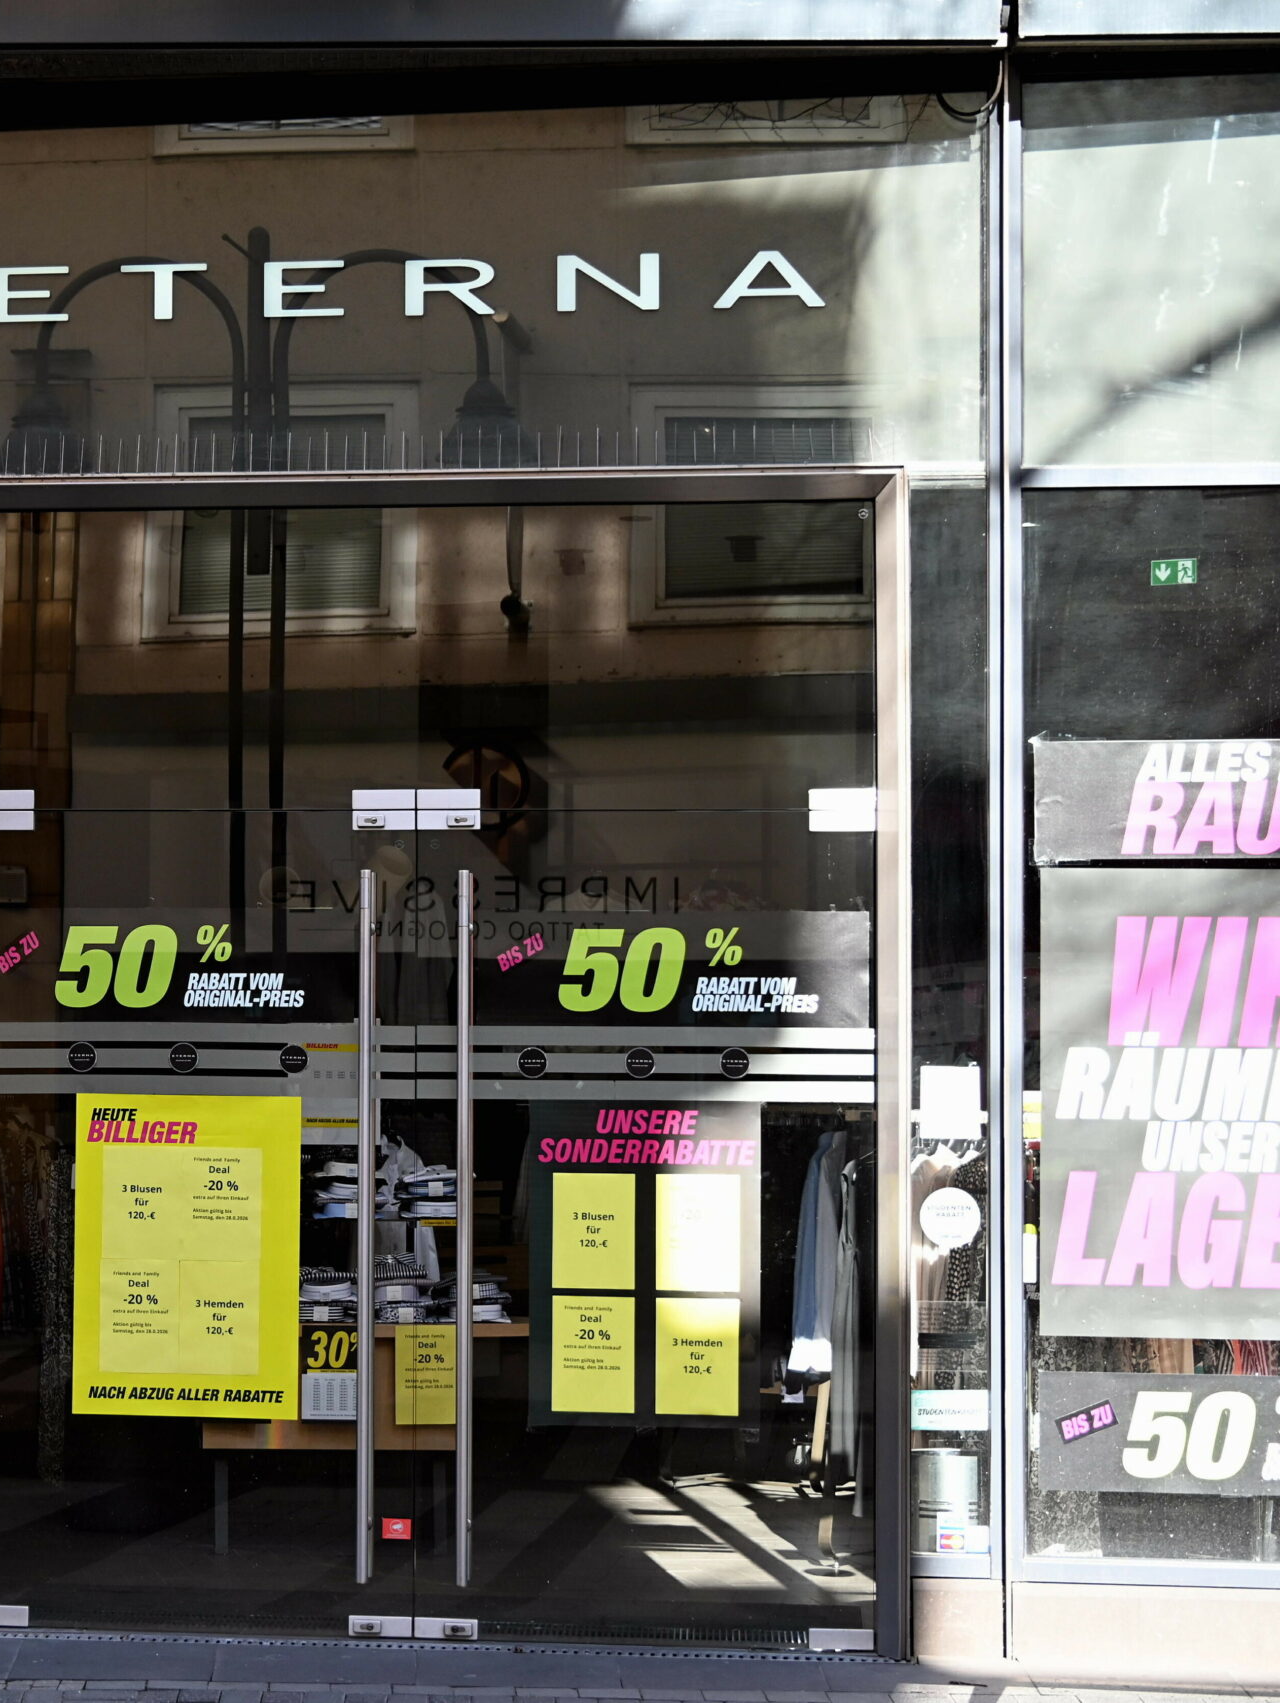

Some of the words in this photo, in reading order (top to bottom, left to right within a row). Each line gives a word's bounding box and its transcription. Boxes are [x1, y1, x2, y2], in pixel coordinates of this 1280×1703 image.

[1136, 742, 1272, 782] ALLES
[19, 931, 41, 956] ZU
[497, 945, 524, 972] BIS
[523, 933, 545, 957] ZU
[55, 924, 178, 1009] 50
[197, 923, 233, 963] %
[559, 927, 687, 1013] 50
[706, 927, 743, 967] %
[188, 973, 245, 991] RABATT
[249, 973, 284, 991] VOM
[696, 976, 757, 996] RABATT
[760, 977, 797, 996] VOM
[184, 988, 305, 1008] ORIGINAL-PREIS
[692, 993, 819, 1014] ORIGINAL-PREIS
[1055, 1031, 1280, 1122] RÄUM
[91, 1108, 138, 1121] HEUTE
[596, 1109, 699, 1135] UNSERE
[87, 1120, 197, 1144] BILLIGER
[1141, 1120, 1280, 1172] UNSER
[538, 1138, 756, 1167] SONDERRABATTE
[208, 1165, 230, 1174] Deal
[121, 1184, 128, 1193] 3
[130, 1184, 163, 1194] Blusen
[204, 1180, 223, 1191] -20
[226, 1180, 239, 1191] %
[134, 1197, 150, 1207] für
[127, 1211, 156, 1221] 120,-€
[572, 1212, 579, 1220] 3
[581, 1211, 615, 1221] Blusen
[586, 1224, 601, 1234] für
[579, 1239, 608, 1249] 120,-€
[128, 1280, 150, 1288] Deal
[123, 1294, 143, 1305] -20
[146, 1294, 159, 1305] %
[195, 1300, 201, 1308] 3
[203, 1299, 244, 1309] Hemden
[212, 1312, 227, 1322] für
[580, 1314, 602, 1323] Deal
[205, 1326, 234, 1336] 120,-€
[574, 1329, 595, 1340] -20
[598, 1329, 611, 1341] %
[672, 1338, 678, 1347] 3
[680, 1338, 723, 1348] Hemden
[434, 1354, 444, 1364] %
[689, 1351, 705, 1361] für
[683, 1365, 712, 1375] 120,-€
[88, 1386, 125, 1399] NACH
[128, 1387, 175, 1400] ABZUG
[176, 1388, 220, 1402] ALLER
[223, 1390, 285, 1403] RABATTE
[1061, 1413, 1091, 1440] BIS
[1090, 1403, 1114, 1429] ZU
[1121, 1391, 1257, 1480] 50
